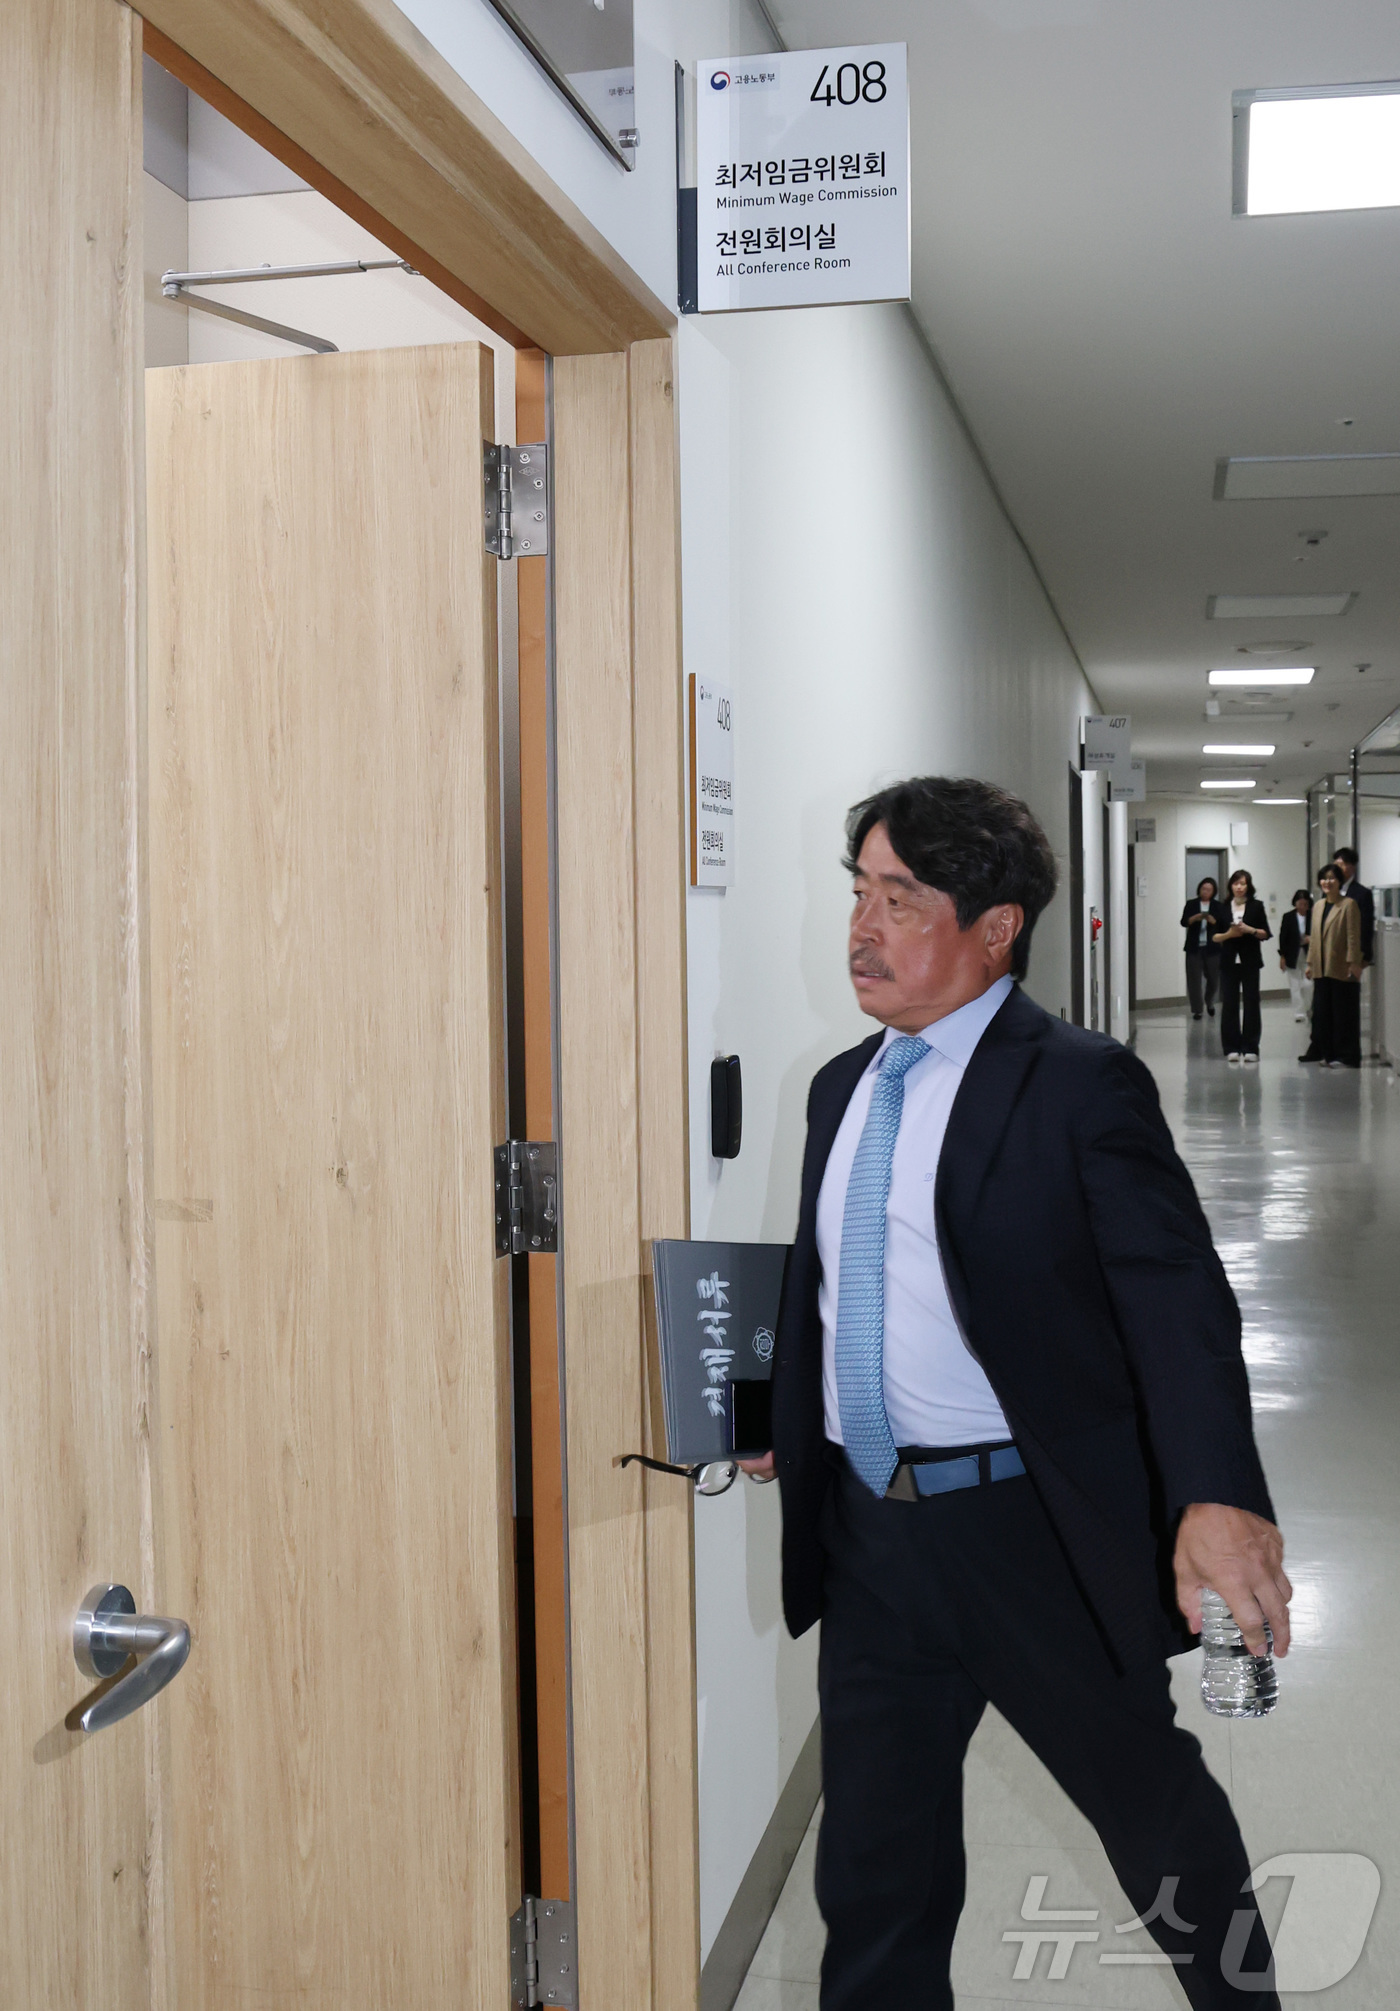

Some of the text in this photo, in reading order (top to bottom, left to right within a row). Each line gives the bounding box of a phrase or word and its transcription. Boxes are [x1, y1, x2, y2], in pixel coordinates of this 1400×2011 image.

[734, 73, 776, 85] 고용노동부
[810, 61, 887, 107] 408
[715, 151, 886, 189] 최저임금위원회
[716, 185, 898, 209] Minimum Wage Commission
[716, 223, 836, 257] 전원회의실
[716, 257, 851, 277] All Conference Room
[717, 697, 731, 732] 408
[1109, 717, 1127, 729] 407
[701, 775, 732, 801] 최저임금위원회
[701, 830, 724, 852] 전원회의실
